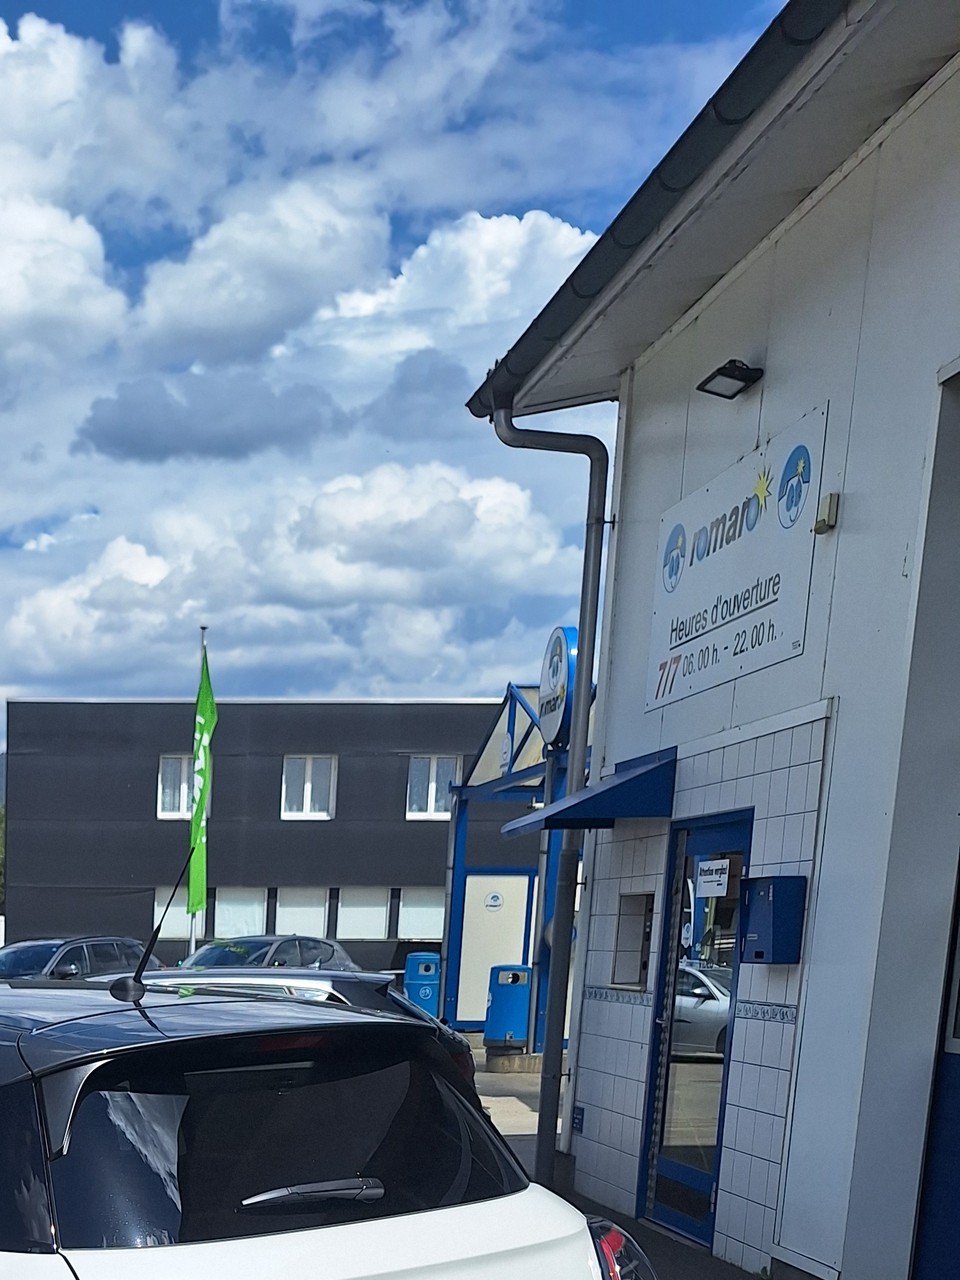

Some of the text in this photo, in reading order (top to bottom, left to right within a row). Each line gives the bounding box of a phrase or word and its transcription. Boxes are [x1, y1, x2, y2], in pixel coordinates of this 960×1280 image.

[689, 494, 759, 567] romaro
[670, 573, 781, 645] Heures d'ouverture
[655, 654, 682, 700] 7/7
[711, 643, 720, 666] h.
